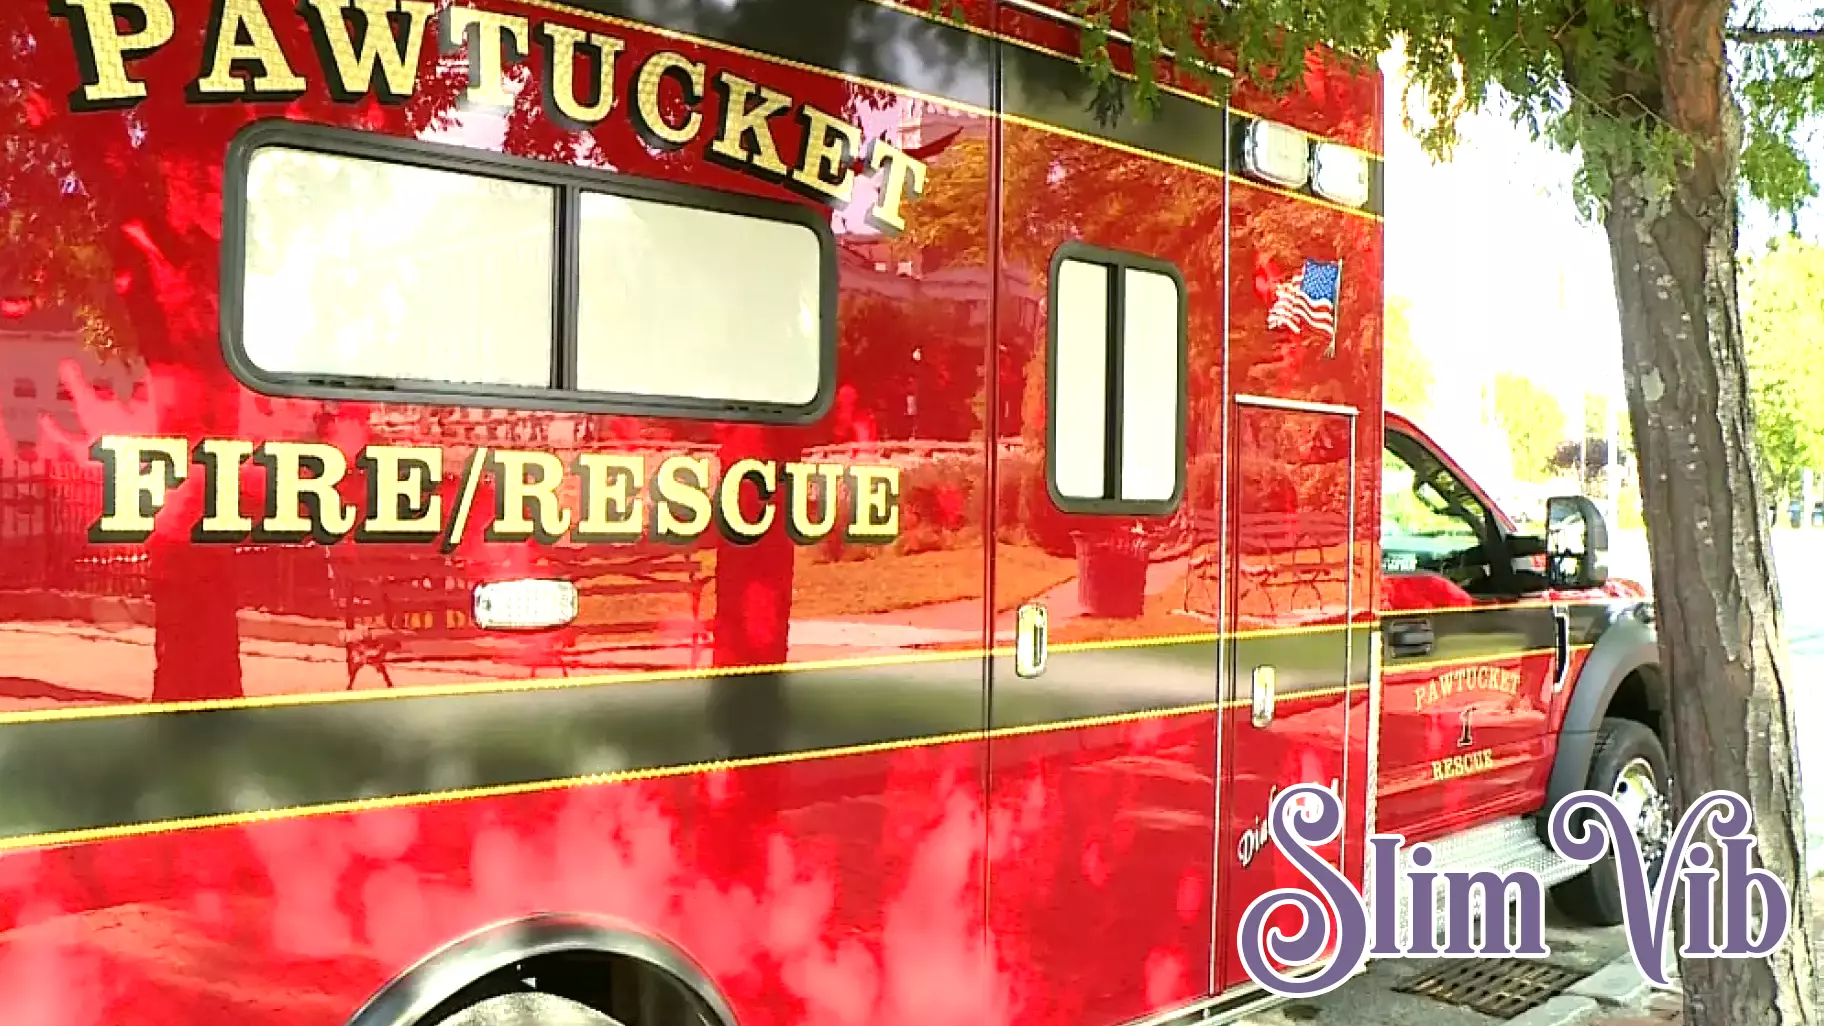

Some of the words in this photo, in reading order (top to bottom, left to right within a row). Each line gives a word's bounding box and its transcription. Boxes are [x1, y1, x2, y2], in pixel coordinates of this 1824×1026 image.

[65, 0, 927, 232] PAWTUCKET
[95, 434, 902, 545] FIRE/RESCUE
[1414, 665, 1521, 711] PAWTUCKET
[1431, 748, 1494, 781] RESCUE
